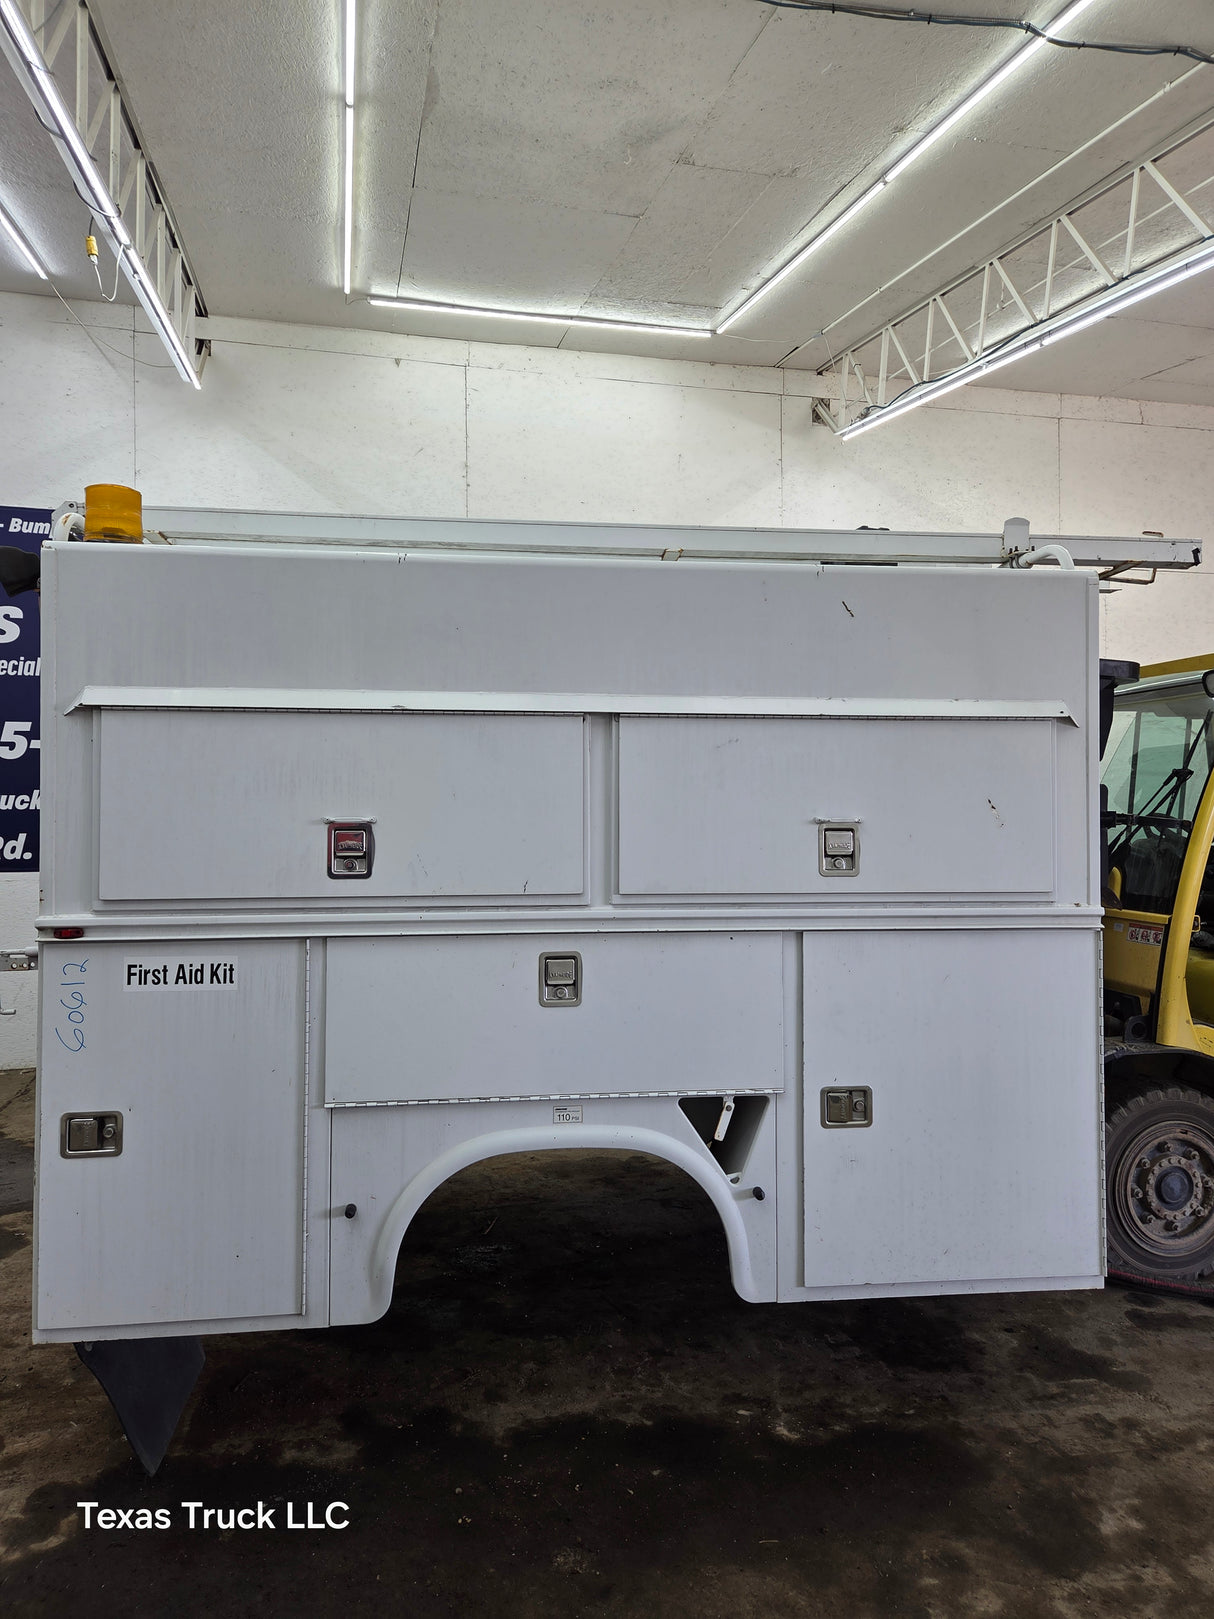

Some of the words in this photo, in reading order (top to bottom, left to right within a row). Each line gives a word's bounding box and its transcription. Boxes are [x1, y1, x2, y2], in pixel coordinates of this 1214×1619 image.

[126, 963, 168, 986] First
[174, 963, 204, 985] Aid
[209, 962, 235, 985] Kit
[557, 1113, 571, 1121] 110
